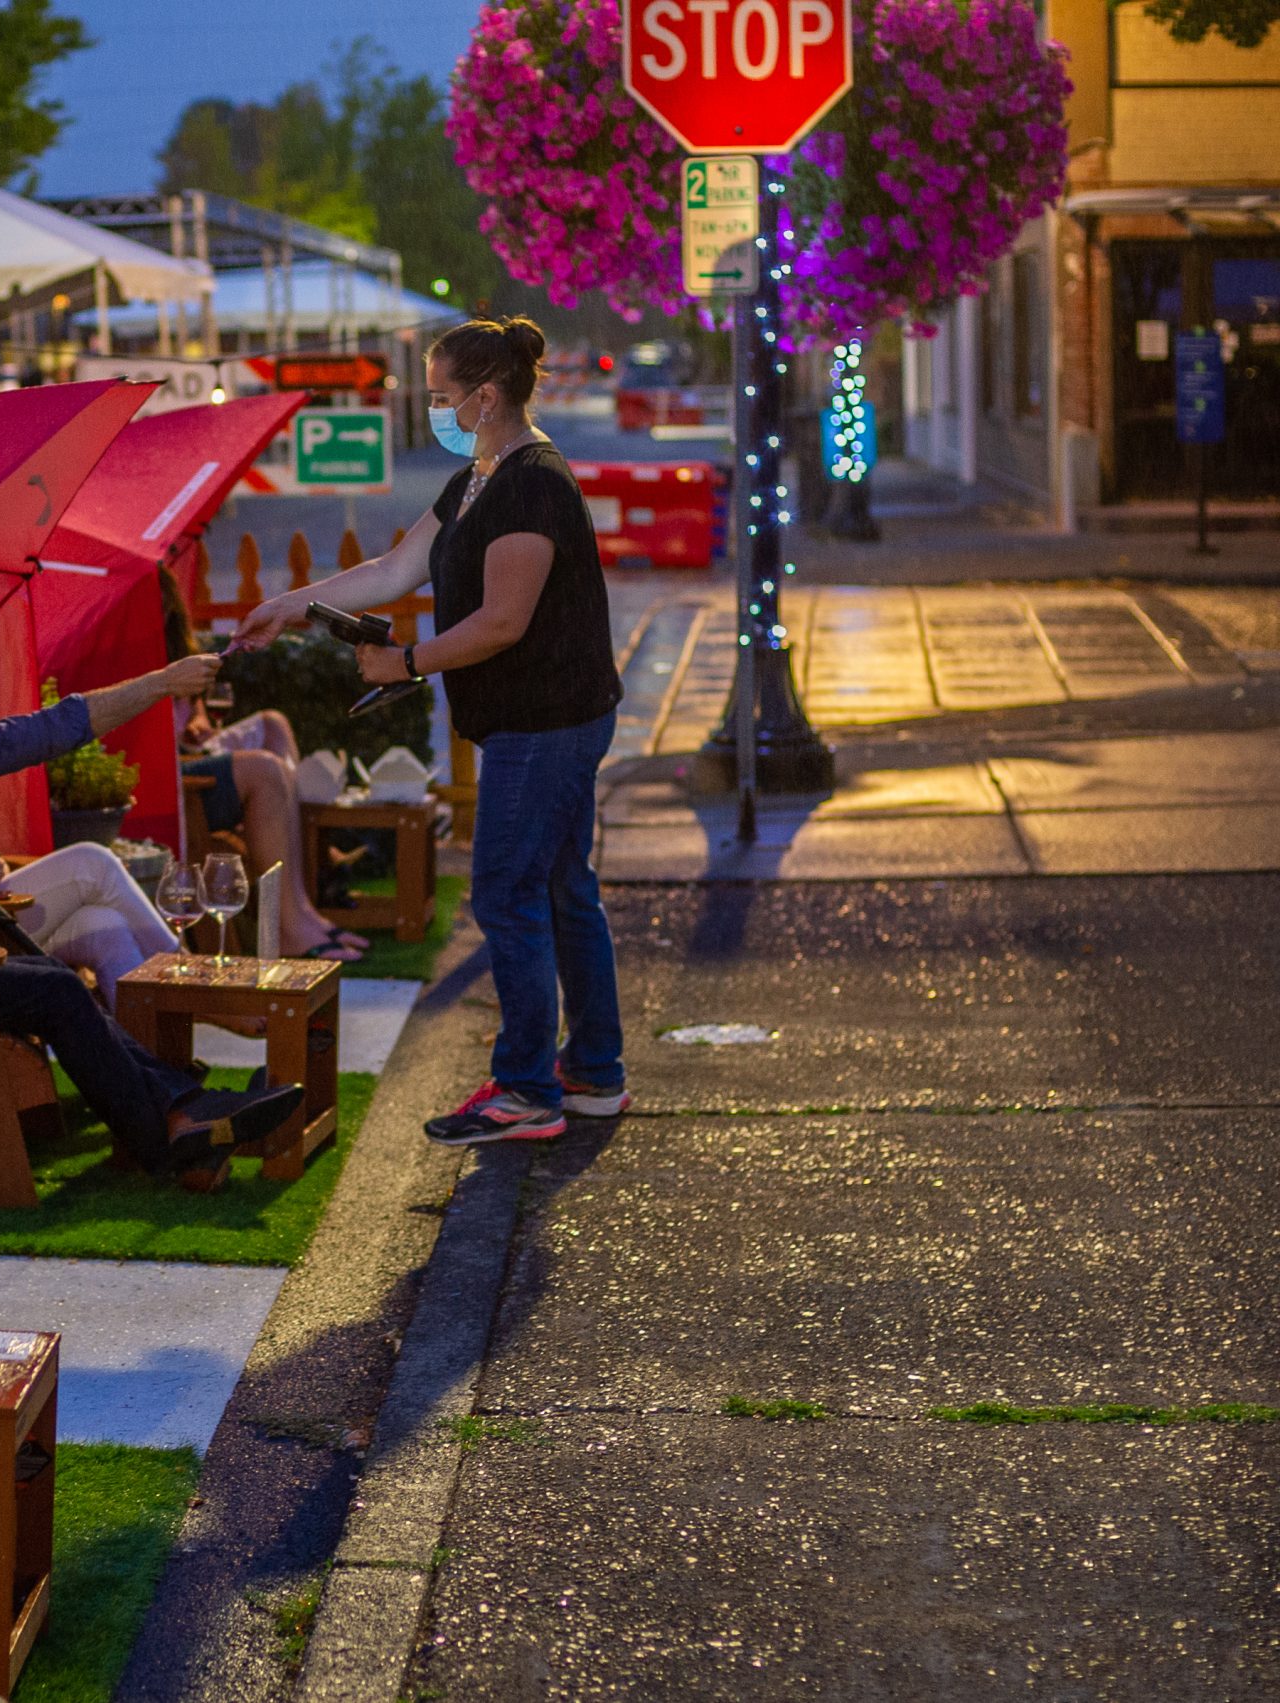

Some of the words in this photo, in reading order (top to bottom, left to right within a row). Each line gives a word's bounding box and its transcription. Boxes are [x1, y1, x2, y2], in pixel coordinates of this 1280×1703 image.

[641, 0, 835, 81] STOP
[688, 169, 705, 202] 2
[302, 419, 333, 455] P
